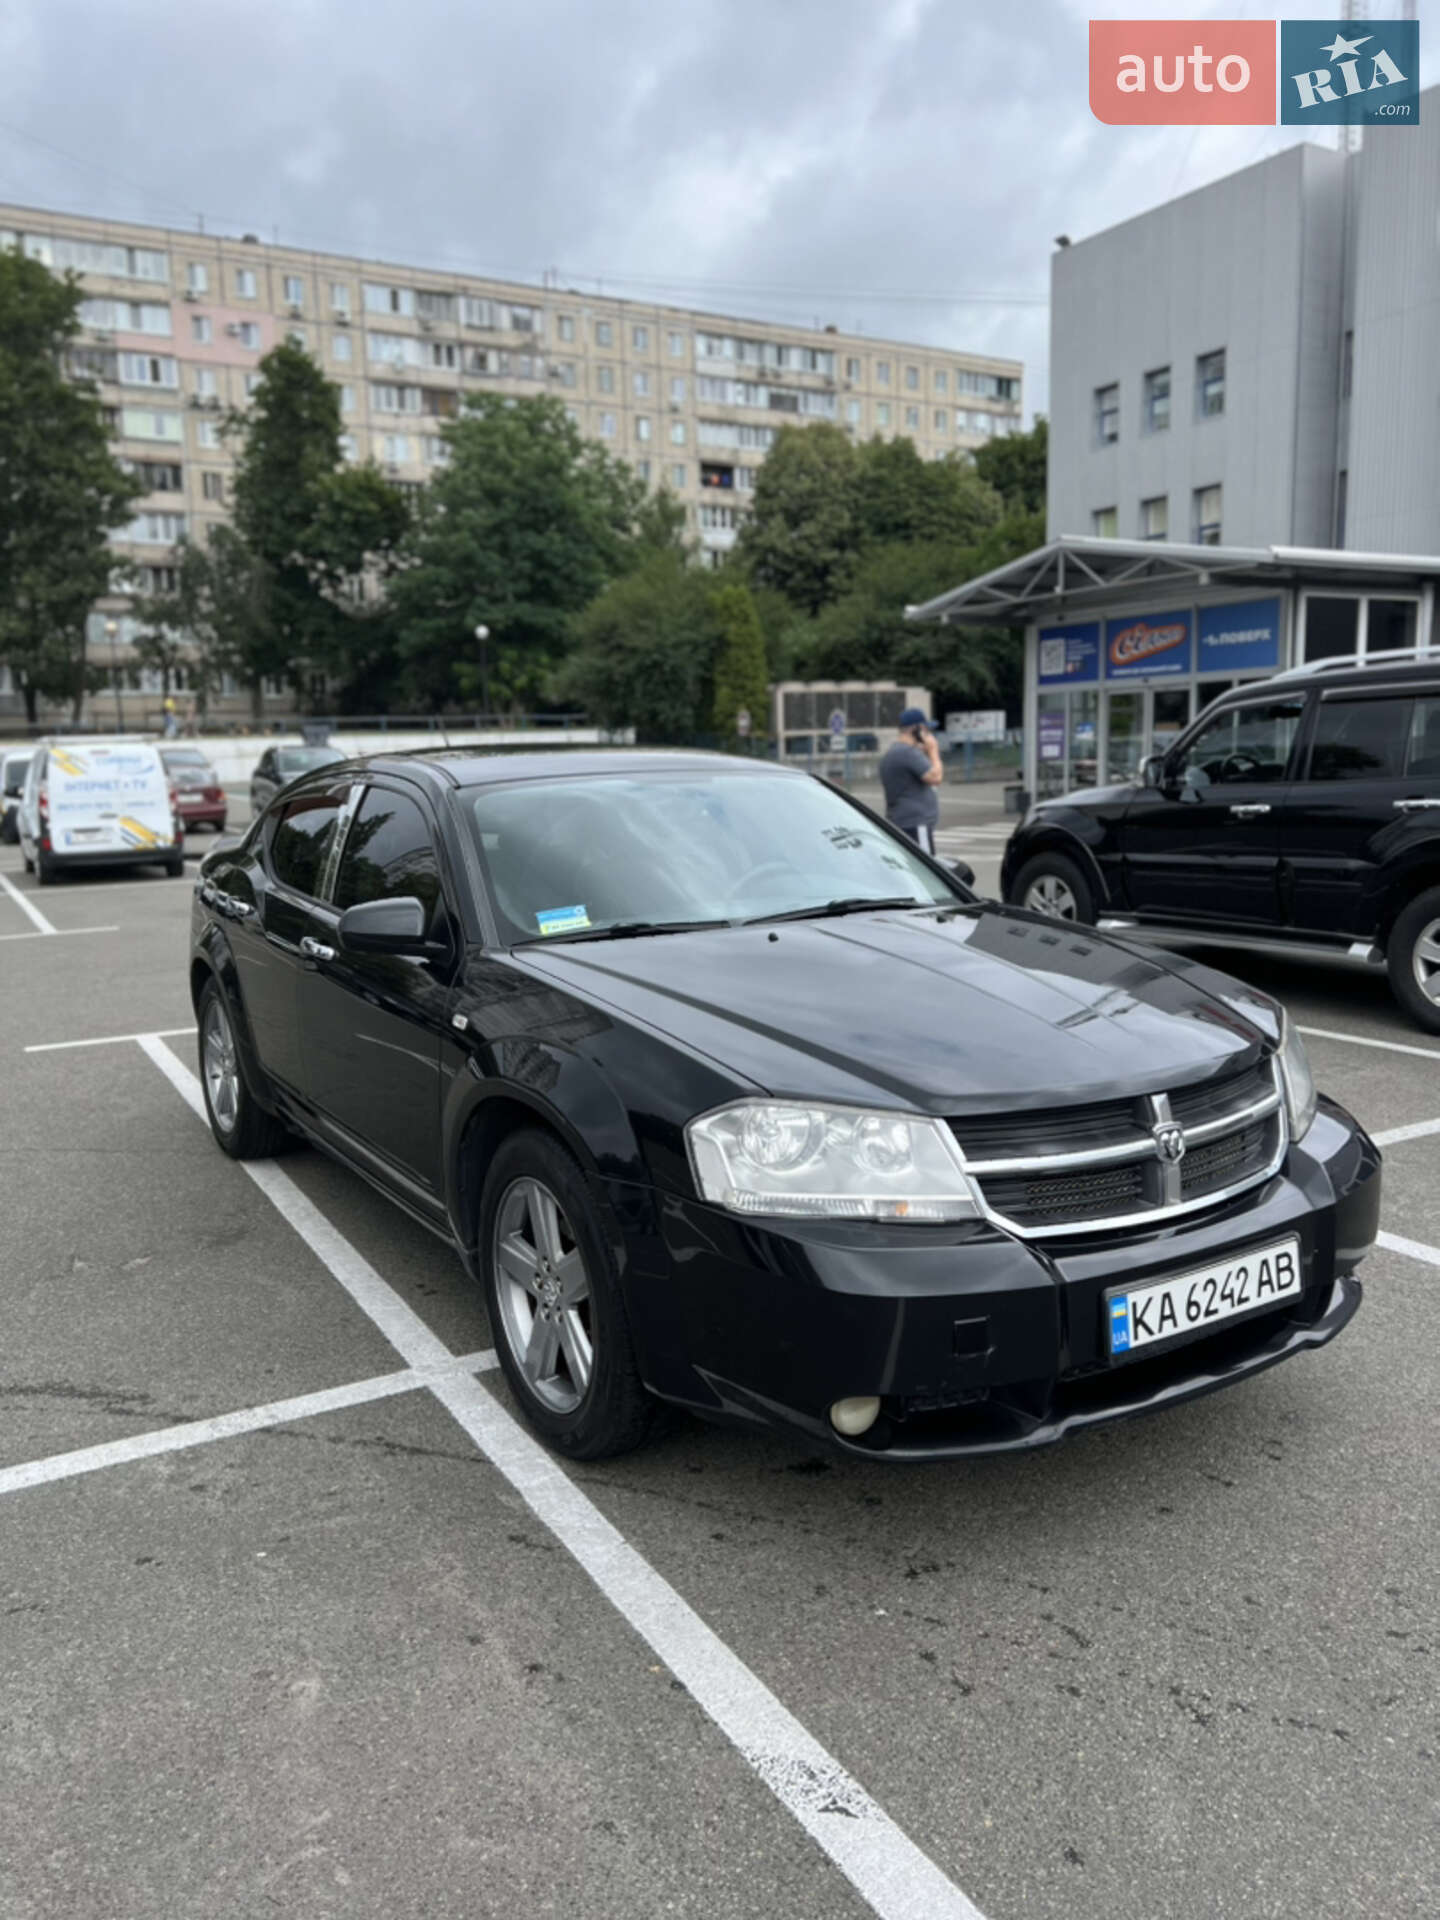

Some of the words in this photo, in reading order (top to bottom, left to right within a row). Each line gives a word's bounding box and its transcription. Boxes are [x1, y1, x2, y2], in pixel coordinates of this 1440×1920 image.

[1131, 1291, 1178, 1341] KA
[1185, 1266, 1250, 1322] 6242
[1257, 1251, 1295, 1298] AB
[1112, 1331, 1128, 1346] UA
